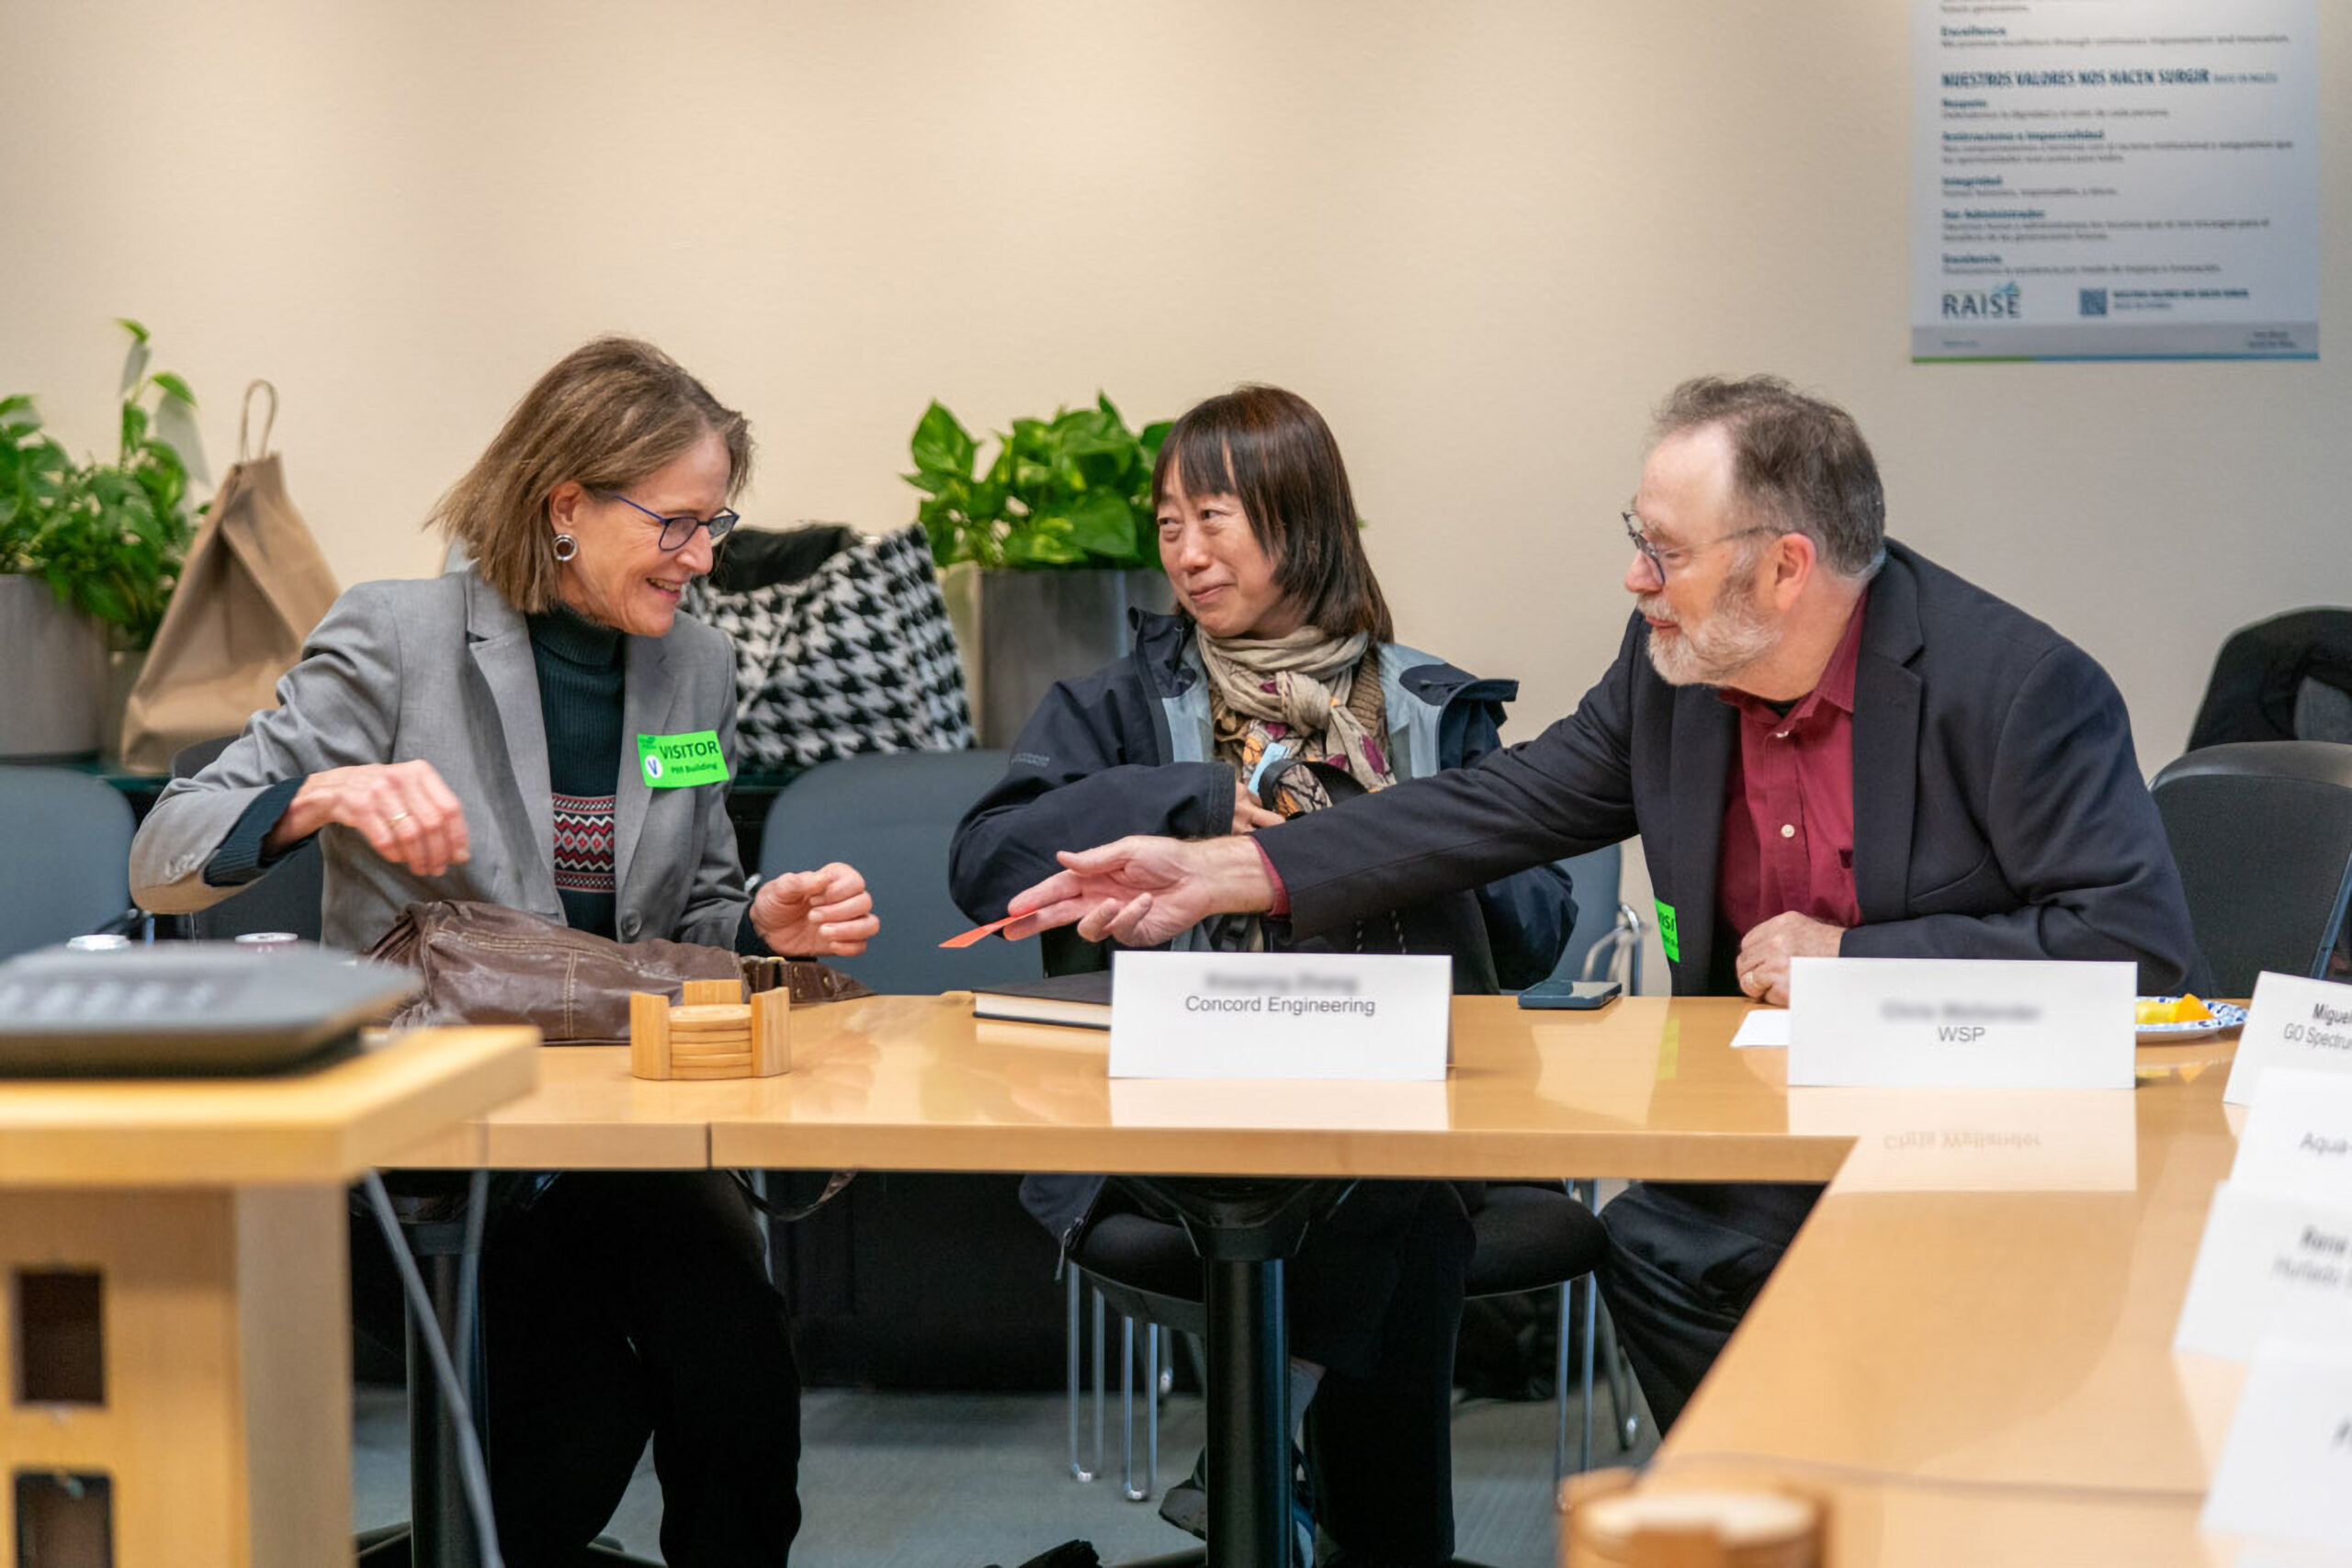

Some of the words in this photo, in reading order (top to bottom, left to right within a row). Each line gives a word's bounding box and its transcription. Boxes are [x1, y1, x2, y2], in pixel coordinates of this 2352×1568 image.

[2017, 70, 2075, 86] VALORES
[2080, 69, 2106, 85] NOS
[2110, 69, 2154, 85] HACEN
[2159, 68, 2210, 85] SURGIR
[1941, 293, 2021, 318] RAISE
[659, 740, 719, 760] VISITOR
[1185, 995, 1261, 1012] Concord
[1268, 996, 1375, 1017] Engineering
[1938, 1026, 1985, 1043] WSP
[2283, 1022, 2304, 1042] GO
